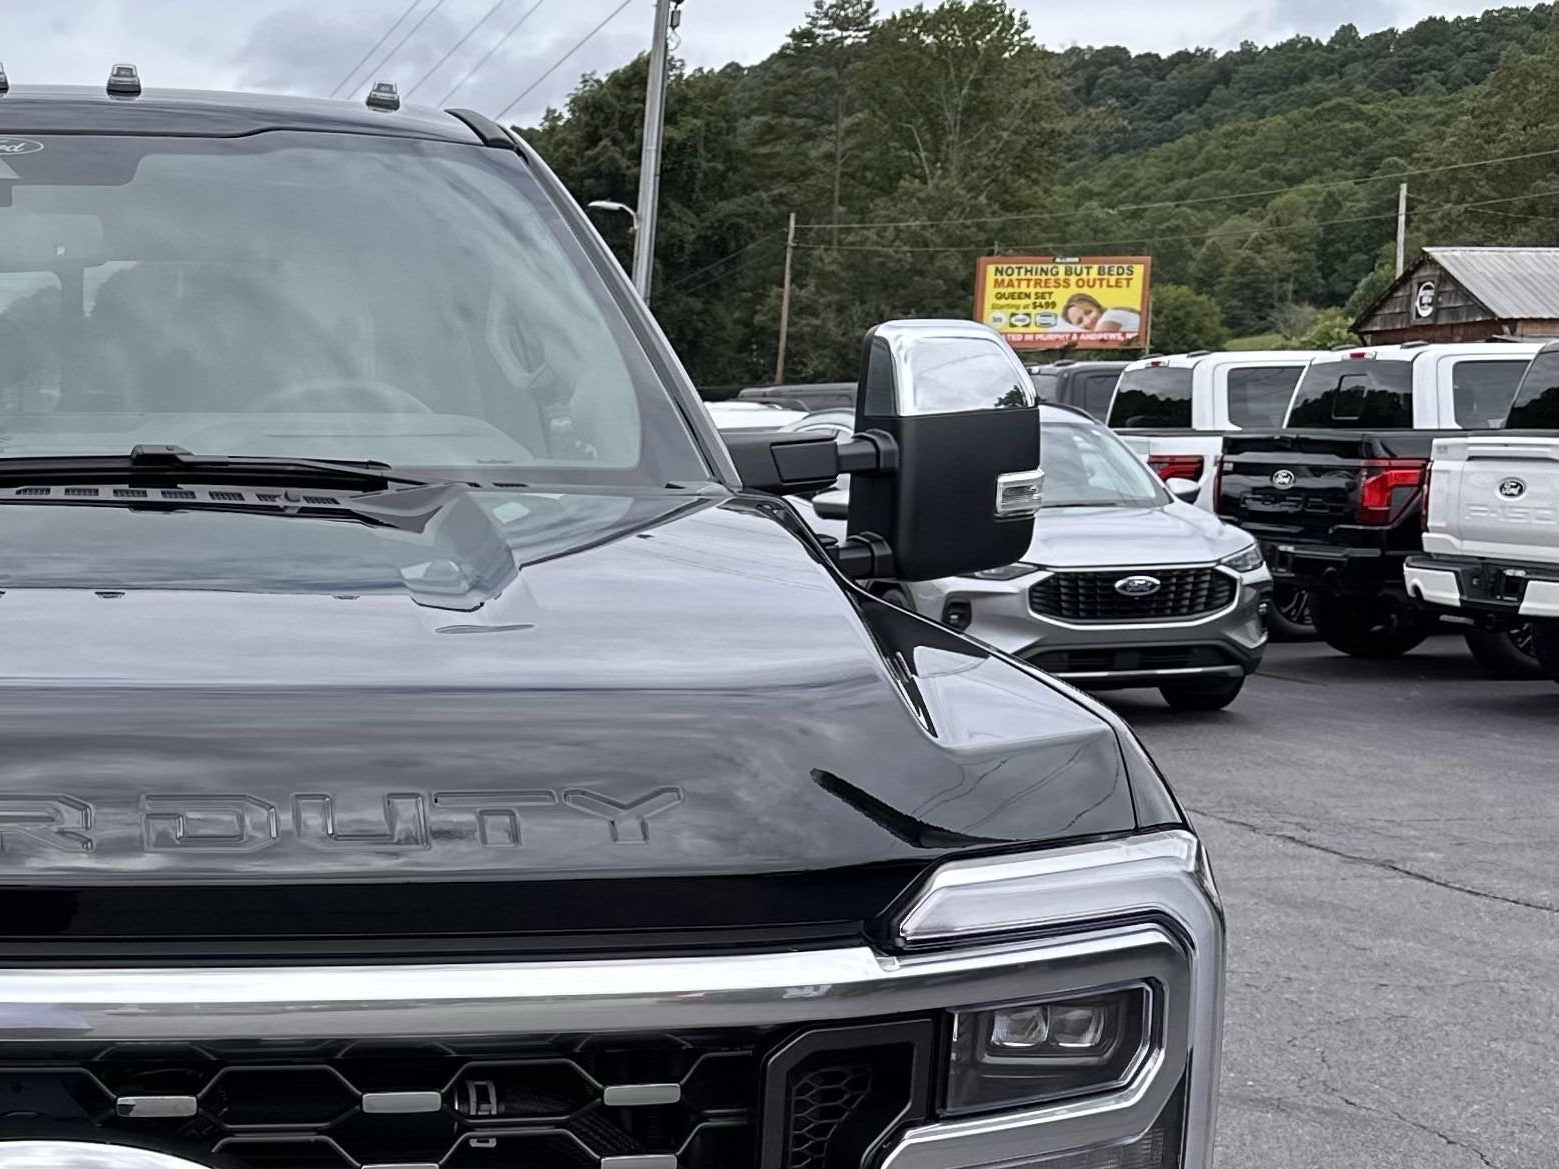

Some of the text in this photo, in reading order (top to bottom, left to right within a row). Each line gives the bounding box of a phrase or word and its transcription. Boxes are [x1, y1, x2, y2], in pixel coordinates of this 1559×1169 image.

[993, 265, 1135, 277] NOTHING BUT BEDS
[993, 278, 1134, 289] MATTRESS OUTLET
[995, 291, 1054, 300] QUEEN SET
[1032, 301, 1057, 310] $499
[141, 784, 686, 853] DUTY
